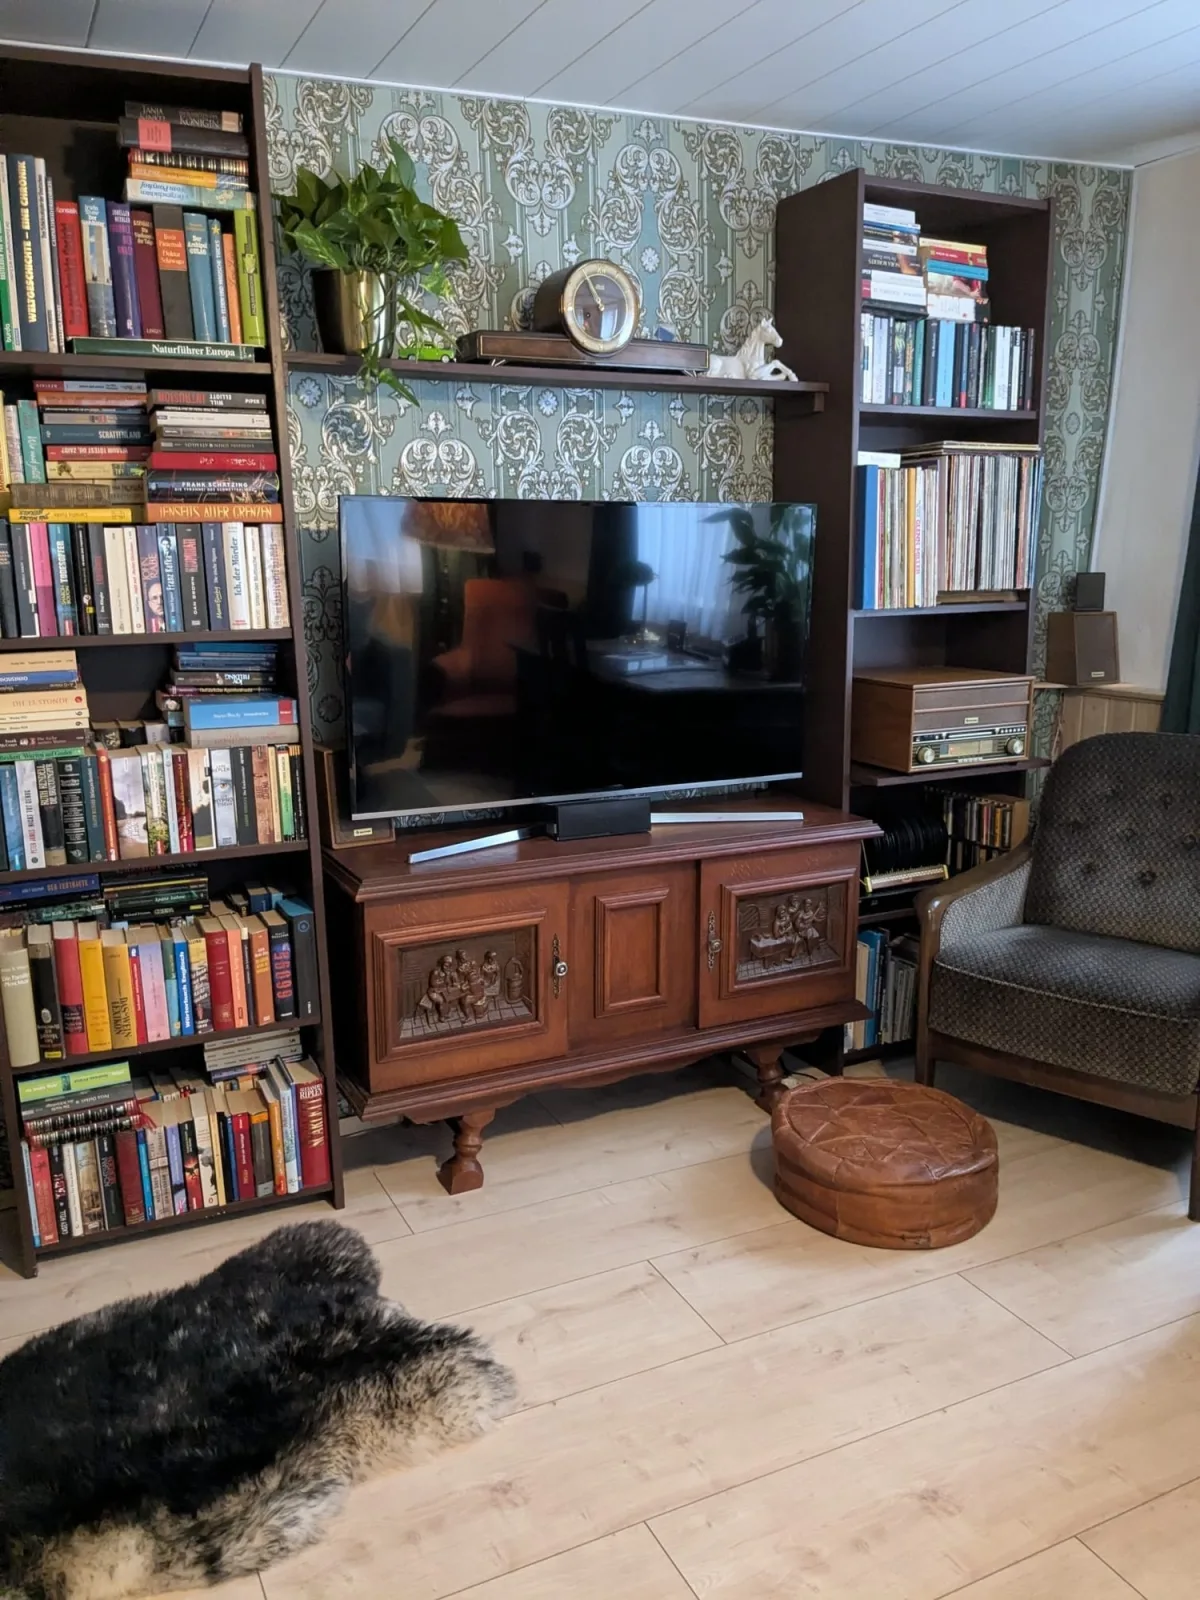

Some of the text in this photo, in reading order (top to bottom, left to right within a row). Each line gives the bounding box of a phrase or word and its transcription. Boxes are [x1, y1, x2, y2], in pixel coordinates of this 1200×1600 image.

[17, 161, 29, 207] CHRONIK
[19, 208, 31, 230] EINE
[22, 240, 38, 323] WELTGESCHICHTE
[4, 323, 12, 344] burda
[152, 343, 236, 358] Naturführer Europa
[208, 480, 248, 488] SCHÄTZING
[159, 504, 272, 518] JENSEITS ALLER GRENZEN
[56, 540, 69, 583] TODESOPFER
[164, 555, 173, 573] Kafka
[230, 537, 242, 596] Ich, der Mörder
[166, 573, 176, 591] Franz
[28, 829, 36, 842] JAMES
[30, 842, 38, 855] PETER
[180, 951, 190, 1028] Wörterbuch Englisch
[111, 1001, 121, 1035] LEXIKON
[300, 1087, 323, 1100] RIPLEY
